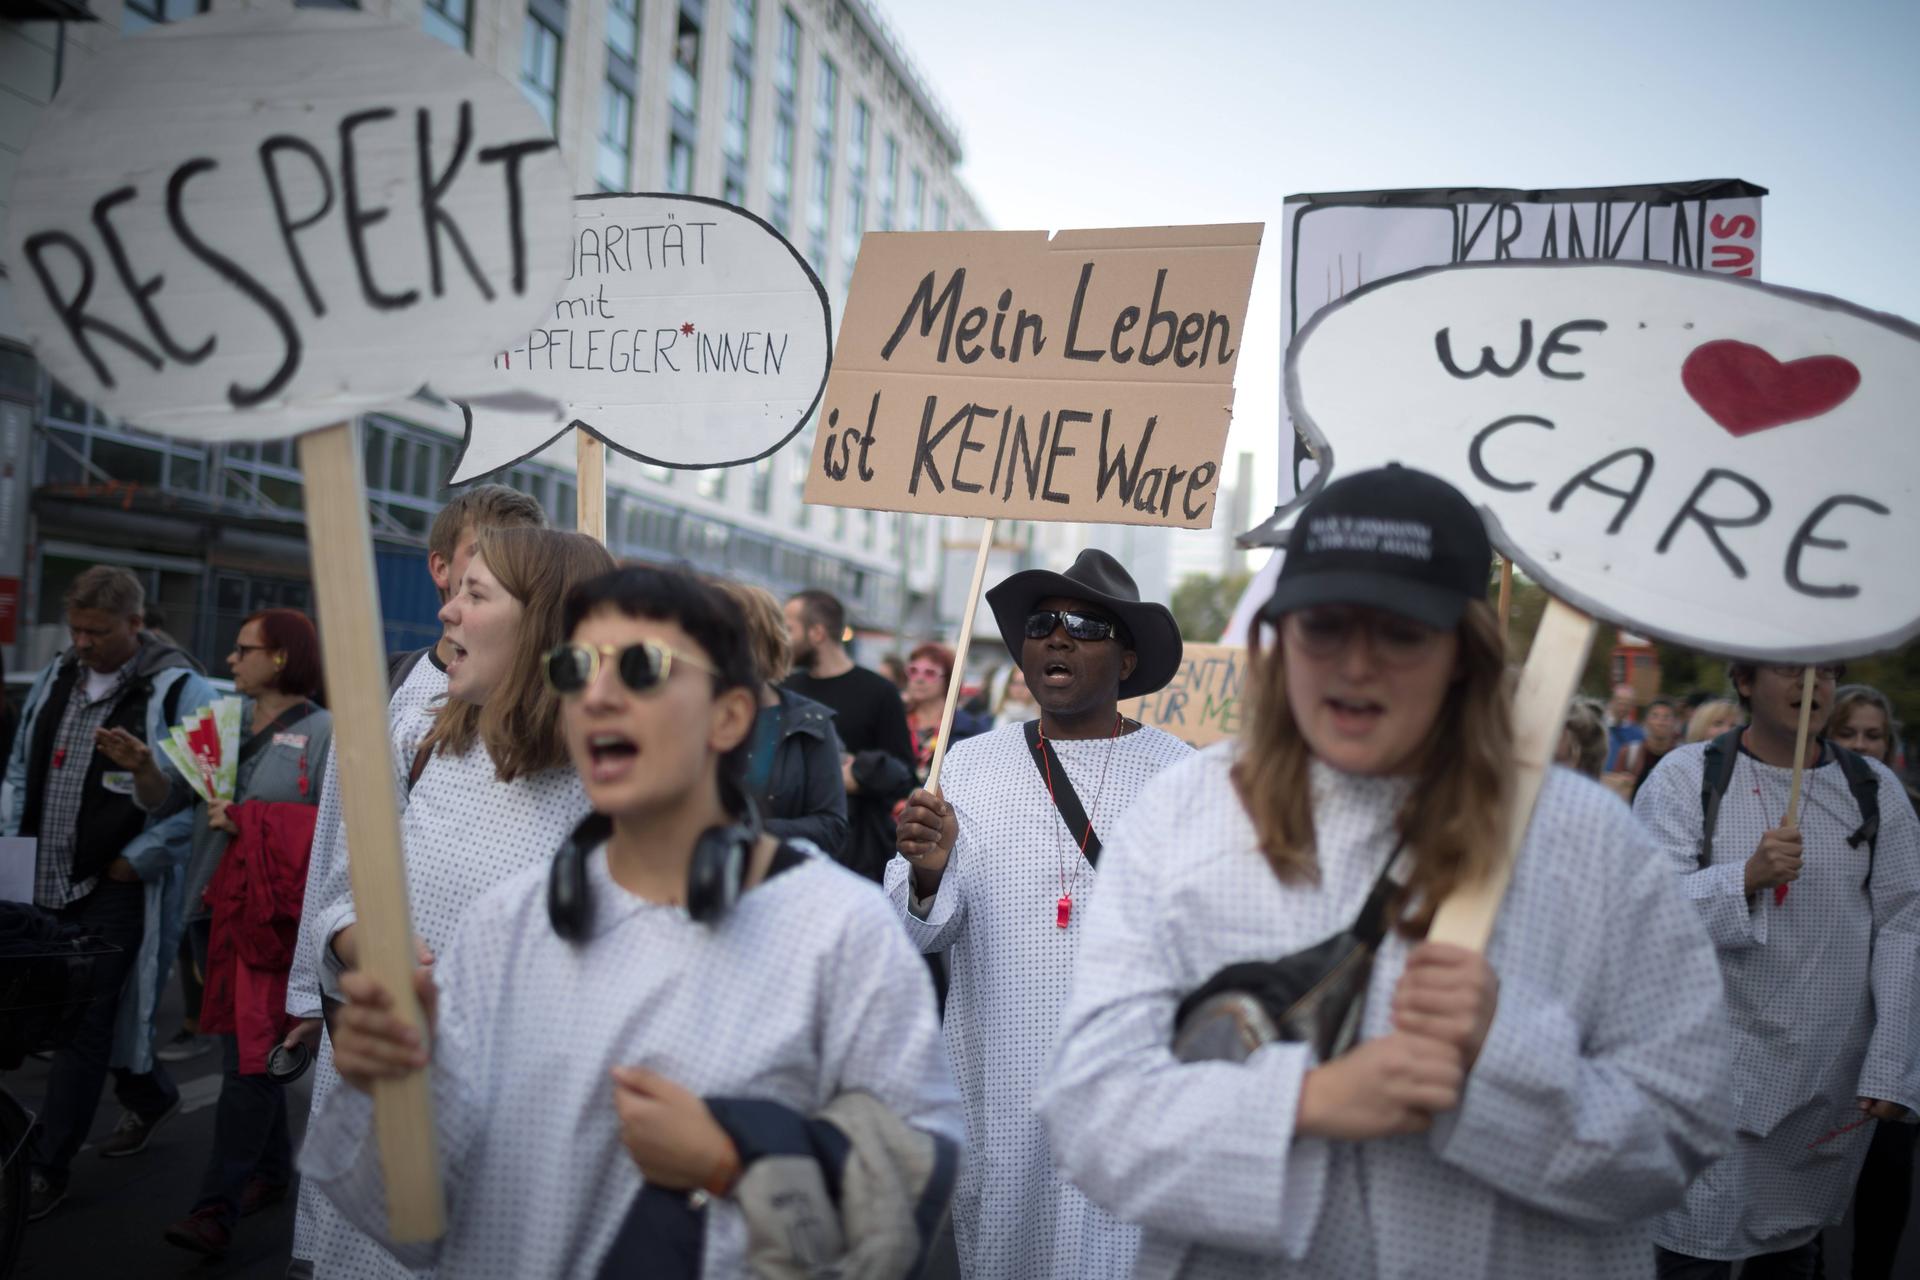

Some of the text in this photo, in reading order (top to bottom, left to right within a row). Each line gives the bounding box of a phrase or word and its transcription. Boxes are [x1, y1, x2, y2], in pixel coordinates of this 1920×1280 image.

[23, 100, 559, 409] RESPEKT
[1709, 213, 1757, 278] US
[556, 284, 615, 320] mit
[880, 259, 1236, 369] Mein Leben
[1434, 317, 1609, 381] WE
[822, 389, 1218, 521] ist KEINE Ware
[1467, 413, 1892, 600] CARE
